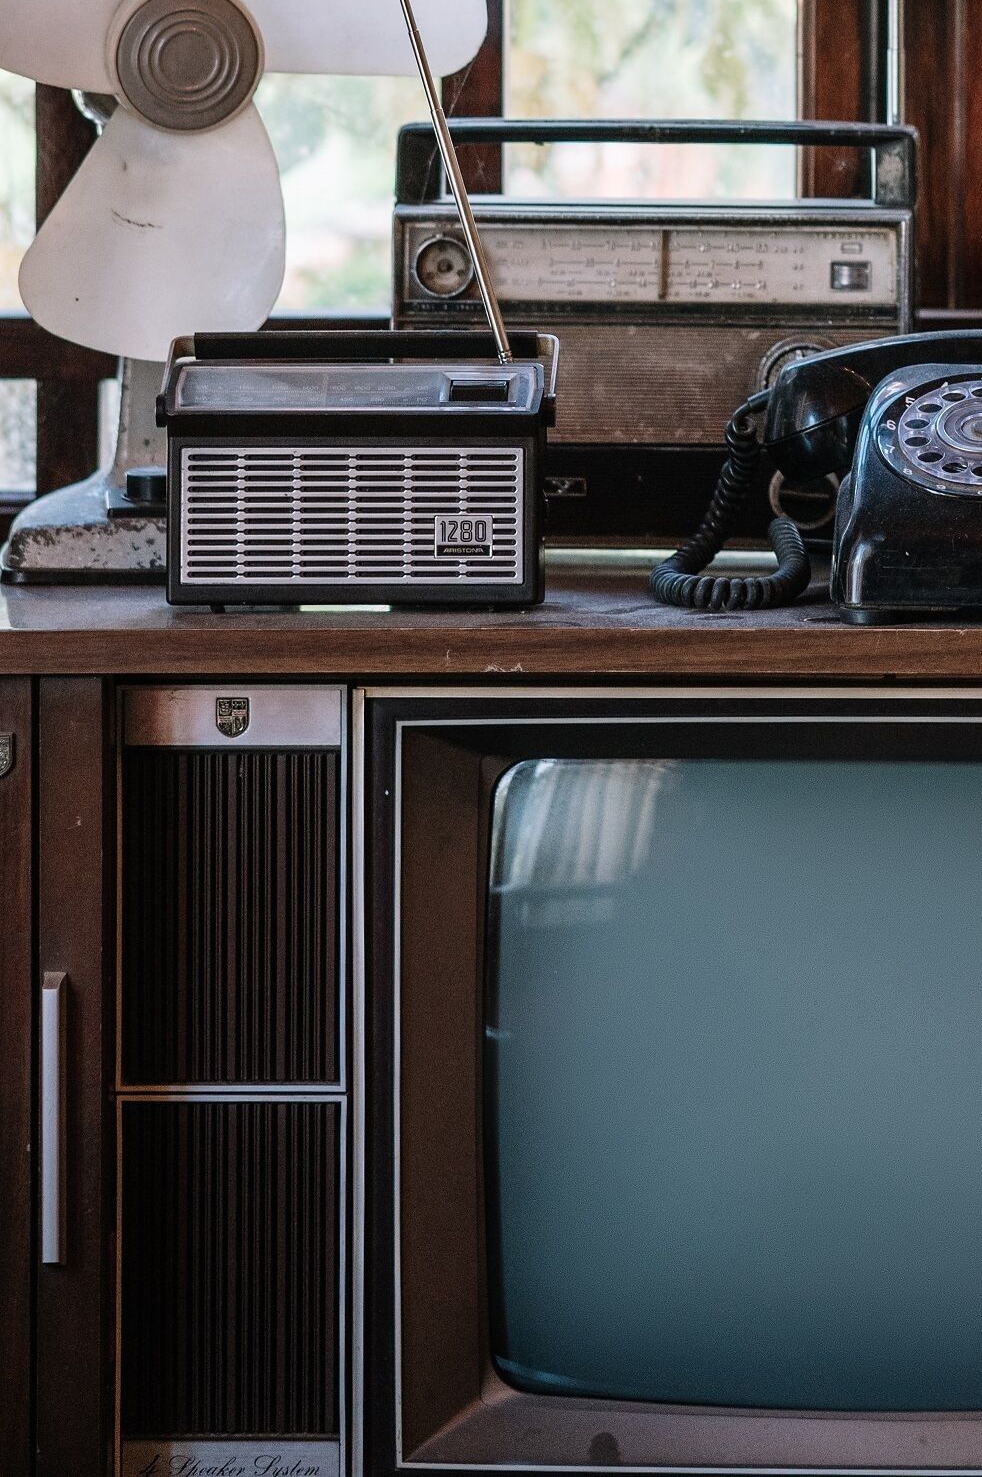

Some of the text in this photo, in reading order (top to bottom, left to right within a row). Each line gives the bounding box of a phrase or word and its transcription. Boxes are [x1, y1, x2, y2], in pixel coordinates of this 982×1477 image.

[440, 520, 487, 543] 1280
[168, 1454, 245, 1477] Speaker
[253, 1454, 321, 1477] System
